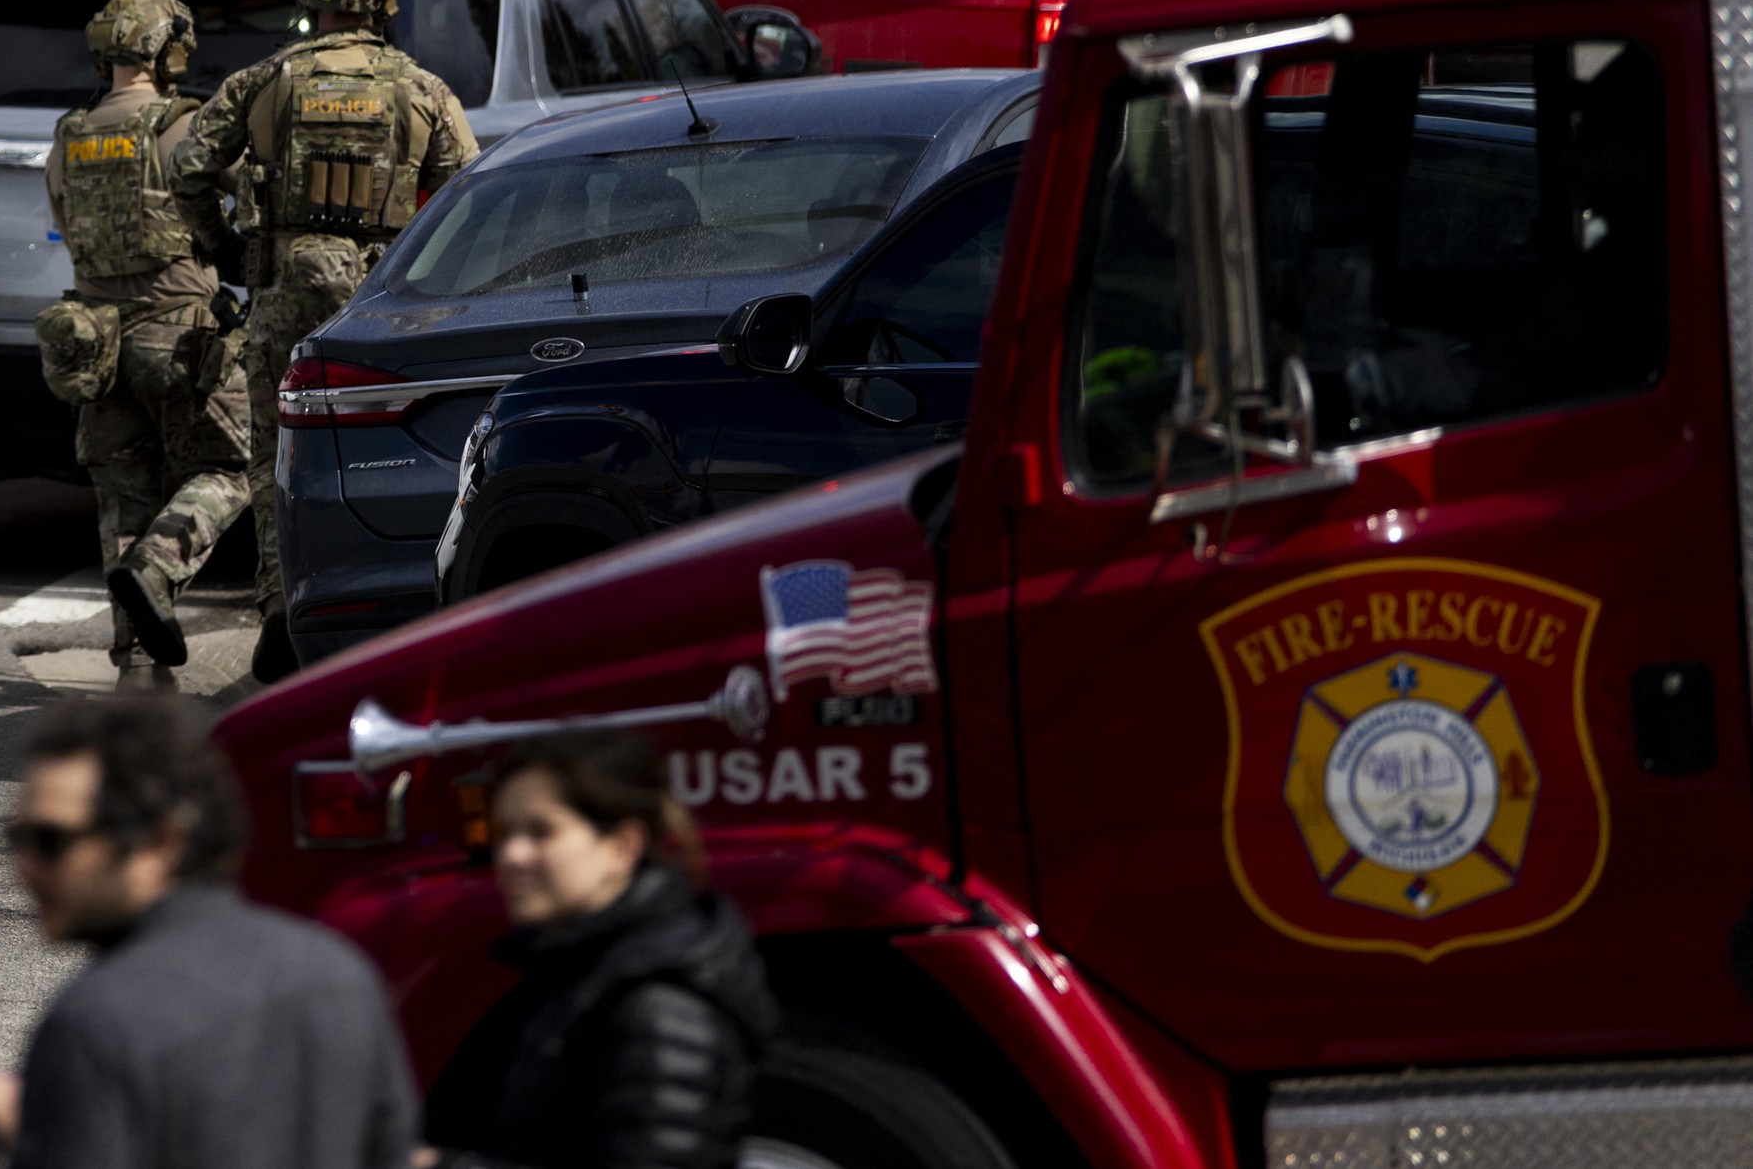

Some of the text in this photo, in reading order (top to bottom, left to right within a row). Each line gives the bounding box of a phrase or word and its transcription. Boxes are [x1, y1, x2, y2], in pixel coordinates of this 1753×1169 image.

[303, 98, 383, 115] POLICE
[67, 134, 138, 165] POLICE
[541, 342, 573, 358] Ford
[670, 742, 934, 808] USAR 5
